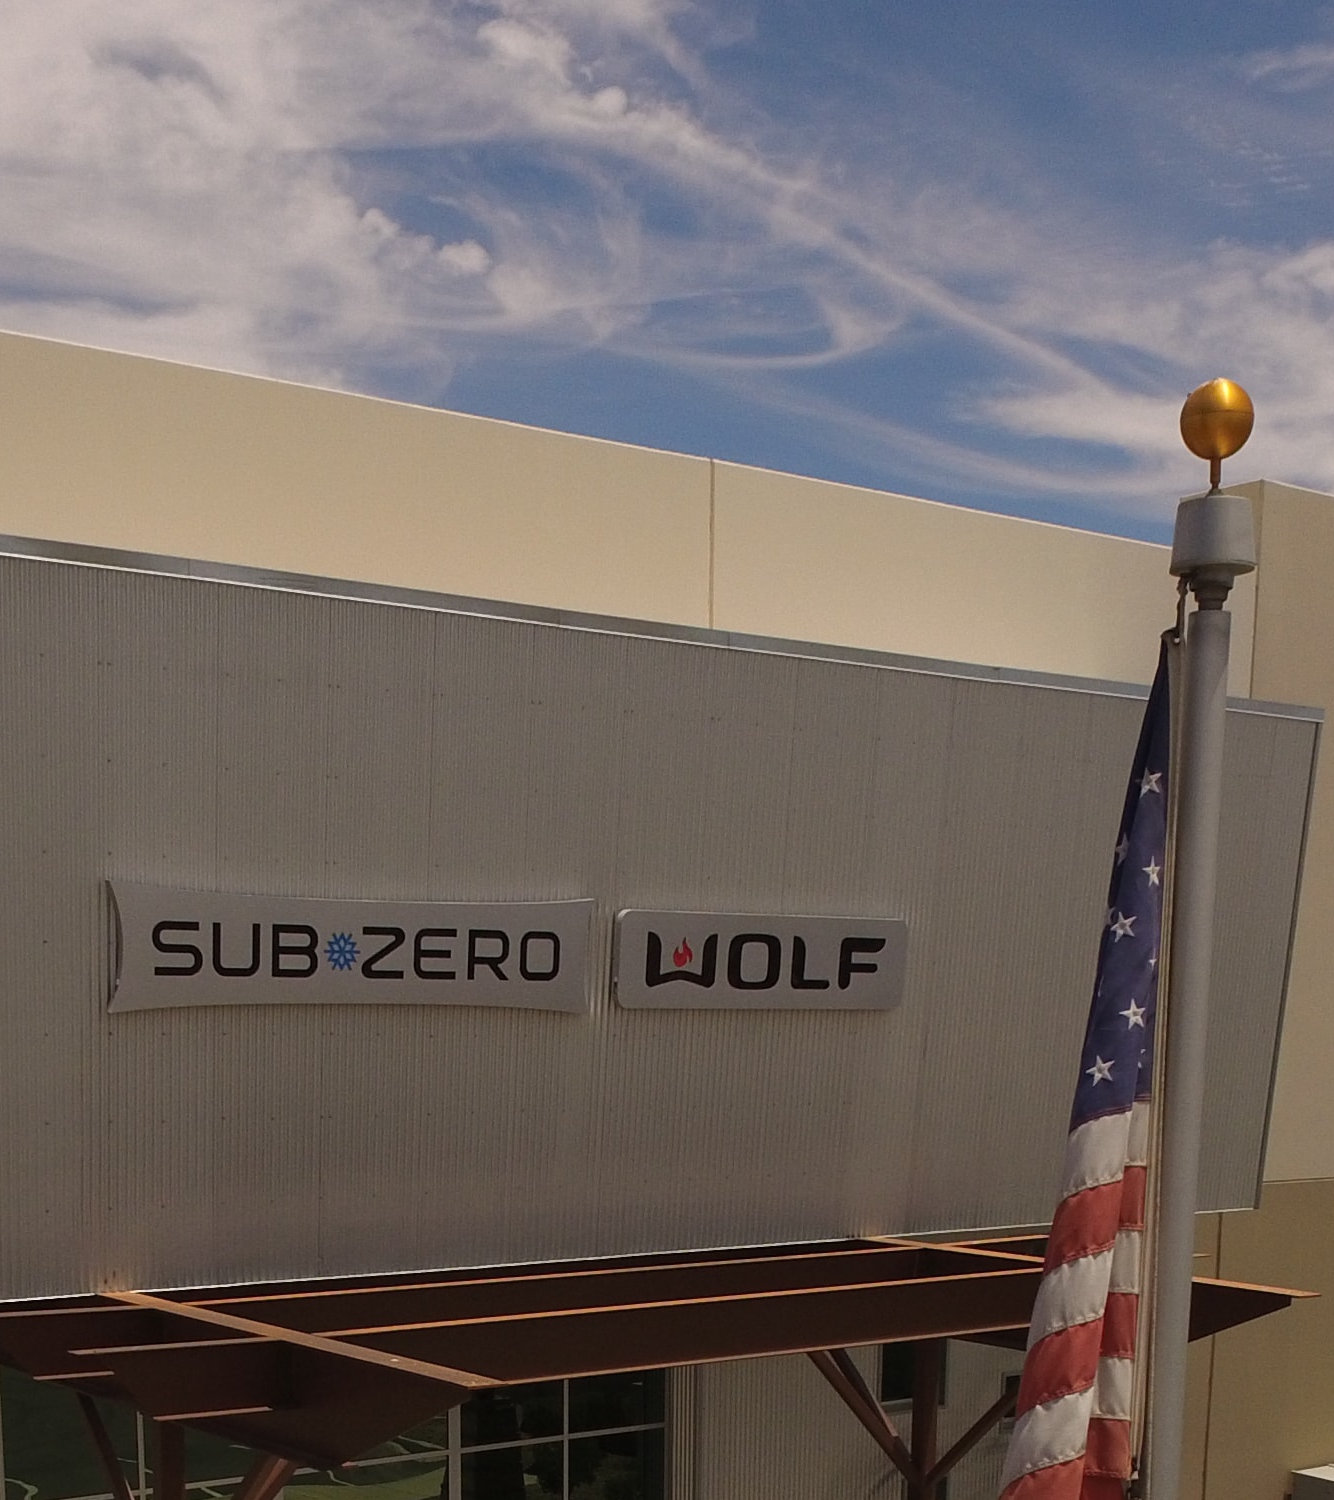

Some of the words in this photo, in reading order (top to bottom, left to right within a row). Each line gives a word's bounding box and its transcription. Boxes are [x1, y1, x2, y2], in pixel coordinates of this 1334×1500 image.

[152, 921, 319, 978] SUB
[361, 926, 561, 982] ZERO
[645, 931, 886, 990] WOLF
